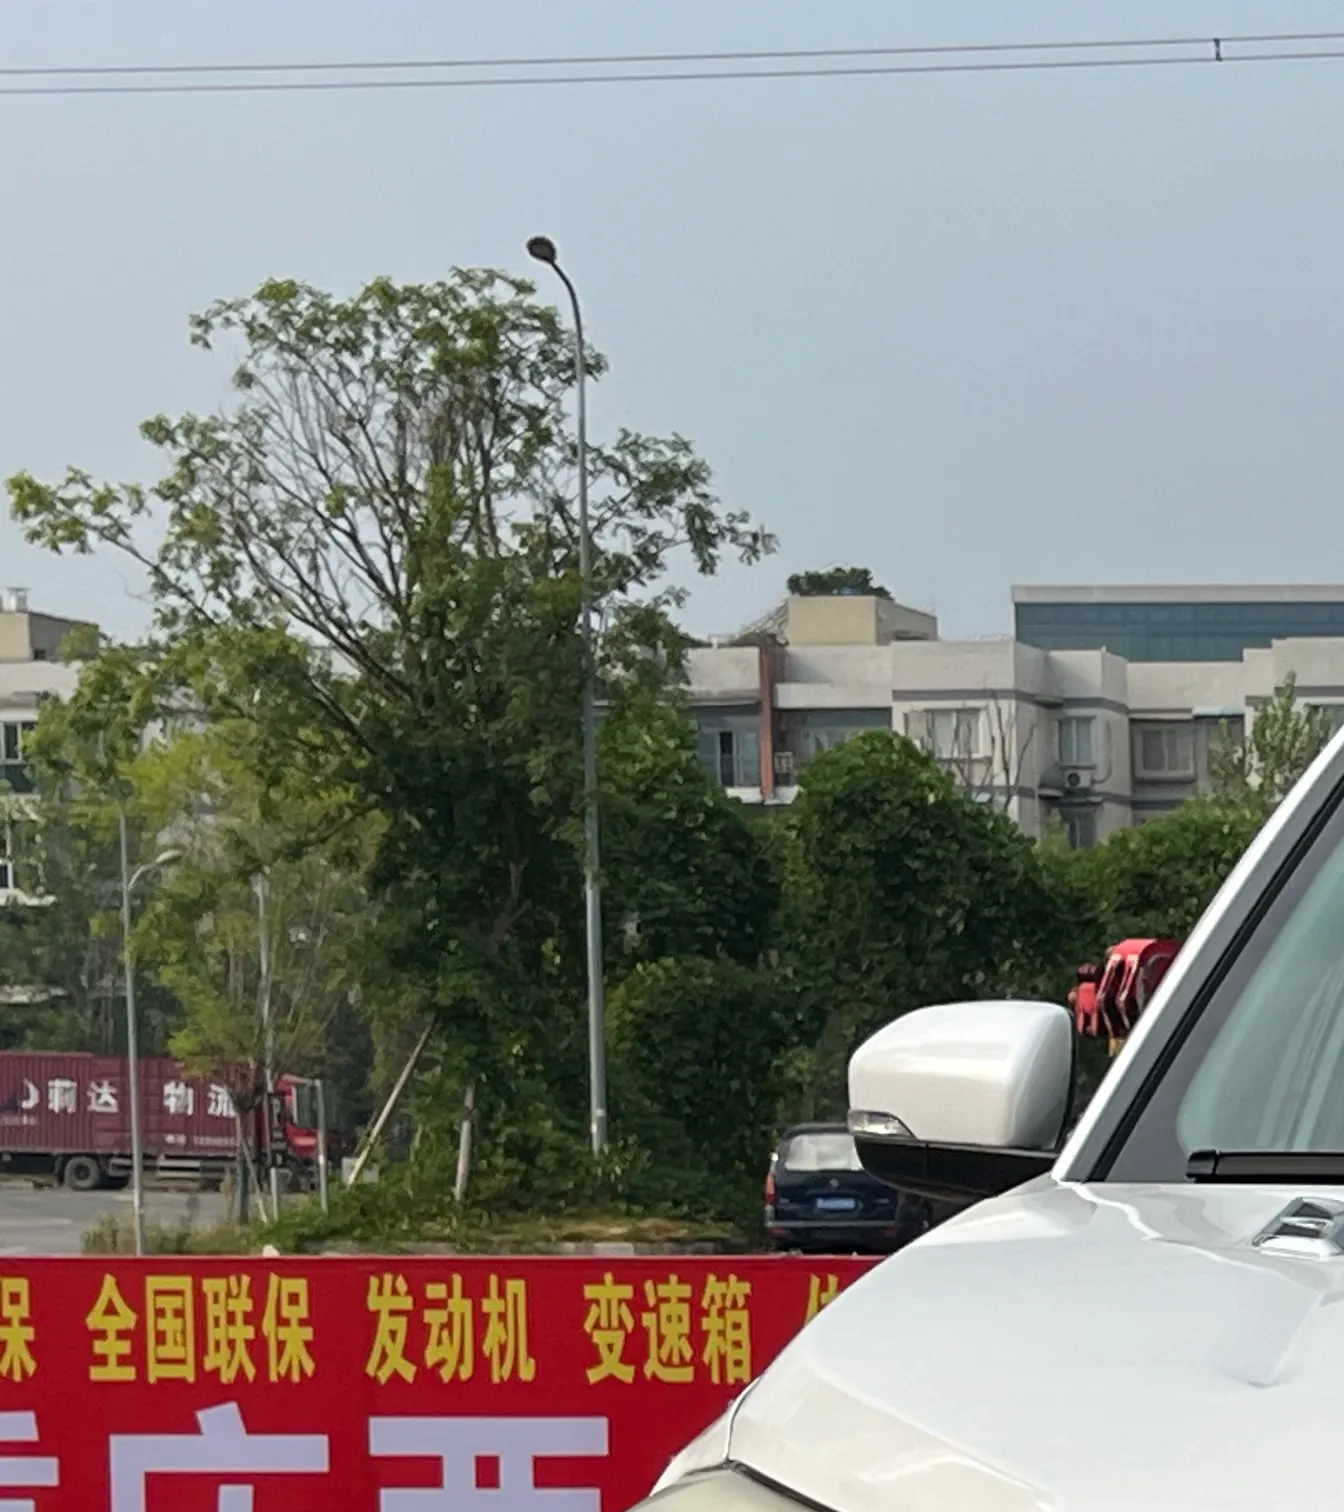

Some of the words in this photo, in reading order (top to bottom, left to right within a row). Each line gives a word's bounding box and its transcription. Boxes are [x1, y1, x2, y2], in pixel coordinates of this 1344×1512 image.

[86, 1273, 314, 1384] 全国联保
[366, 1273, 536, 1384] 发动机
[584, 1273, 752, 1384] 变速箱
